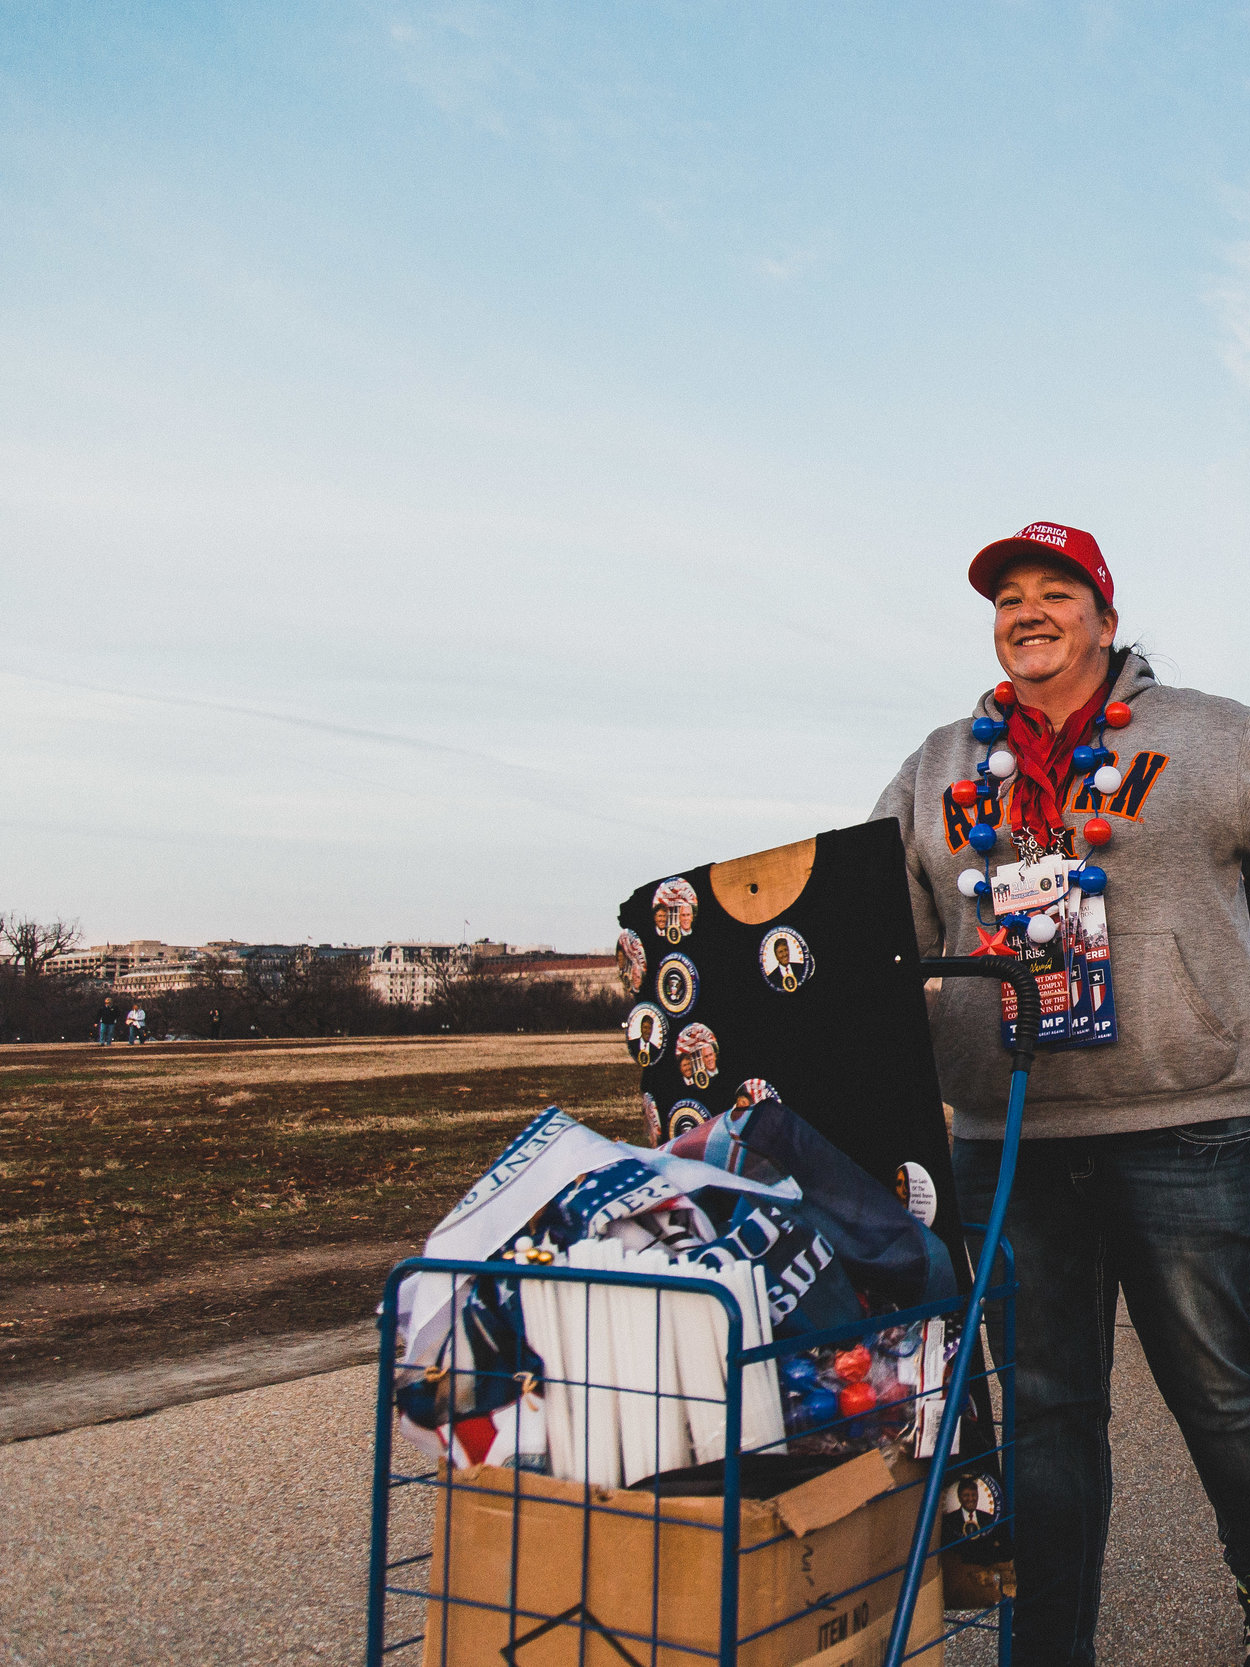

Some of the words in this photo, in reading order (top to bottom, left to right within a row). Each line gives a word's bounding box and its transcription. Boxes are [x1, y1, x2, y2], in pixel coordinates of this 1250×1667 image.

[1025, 525, 1068, 539] AMERICA
[1030, 532, 1067, 548] AGAIN
[1025, 948, 1047, 960] Rise
